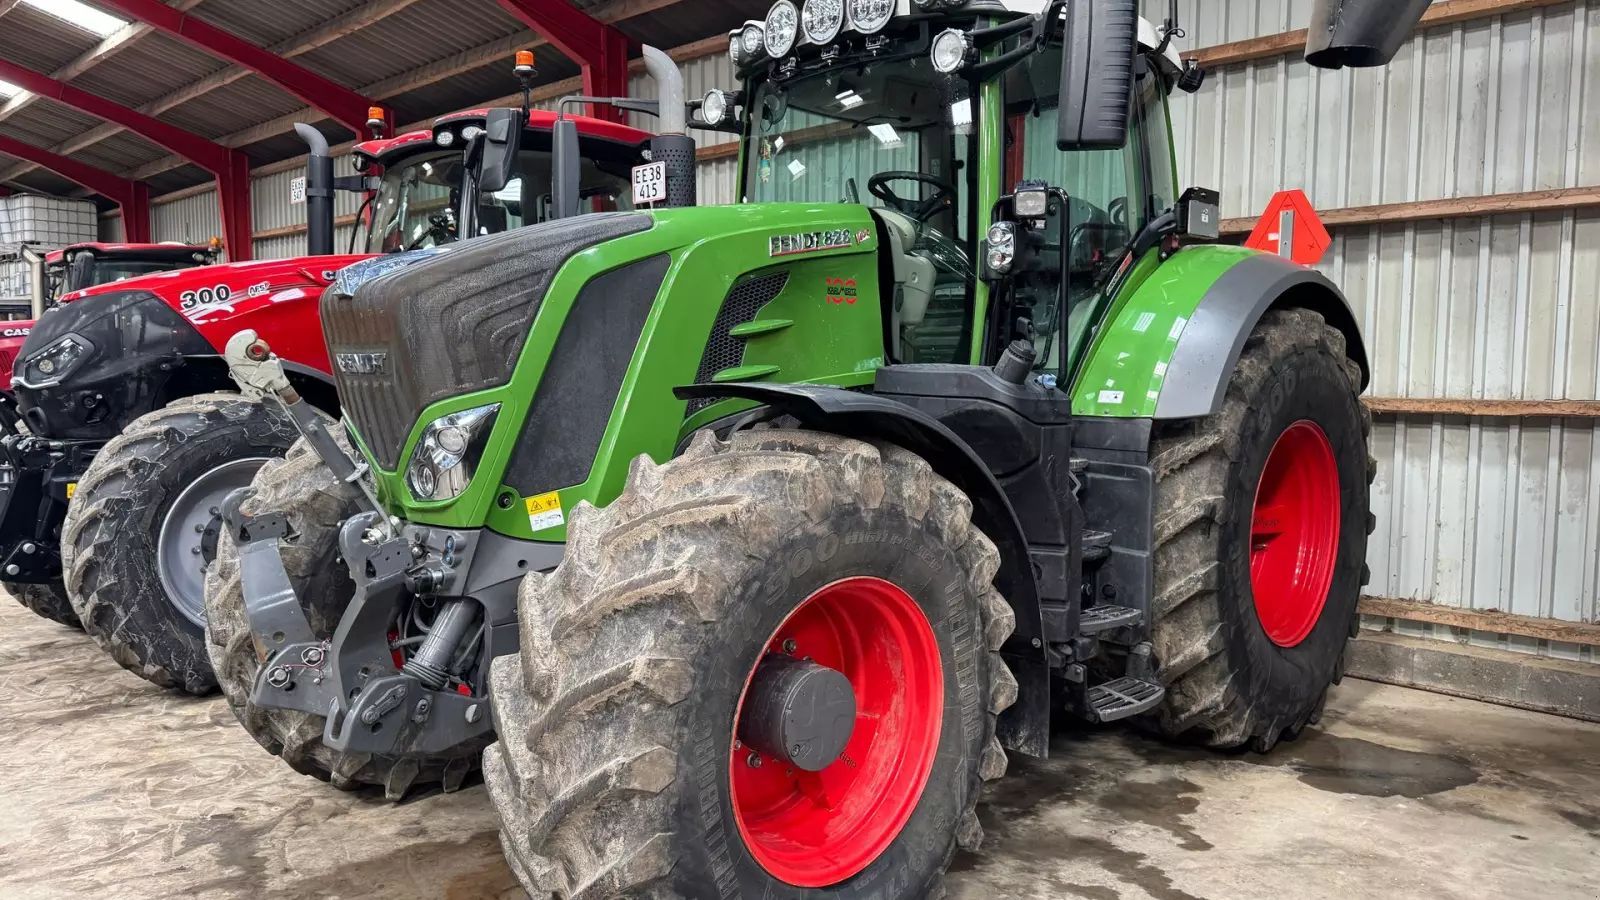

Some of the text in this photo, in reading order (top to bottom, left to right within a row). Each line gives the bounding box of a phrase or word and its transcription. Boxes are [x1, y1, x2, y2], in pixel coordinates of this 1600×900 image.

[636, 166, 661, 184] EE38
[640, 183, 657, 198] 415
[769, 232, 821, 256] FENDT
[823, 229, 851, 246] 828
[181, 286, 231, 309] 300
[4, 328, 31, 337] CAS
